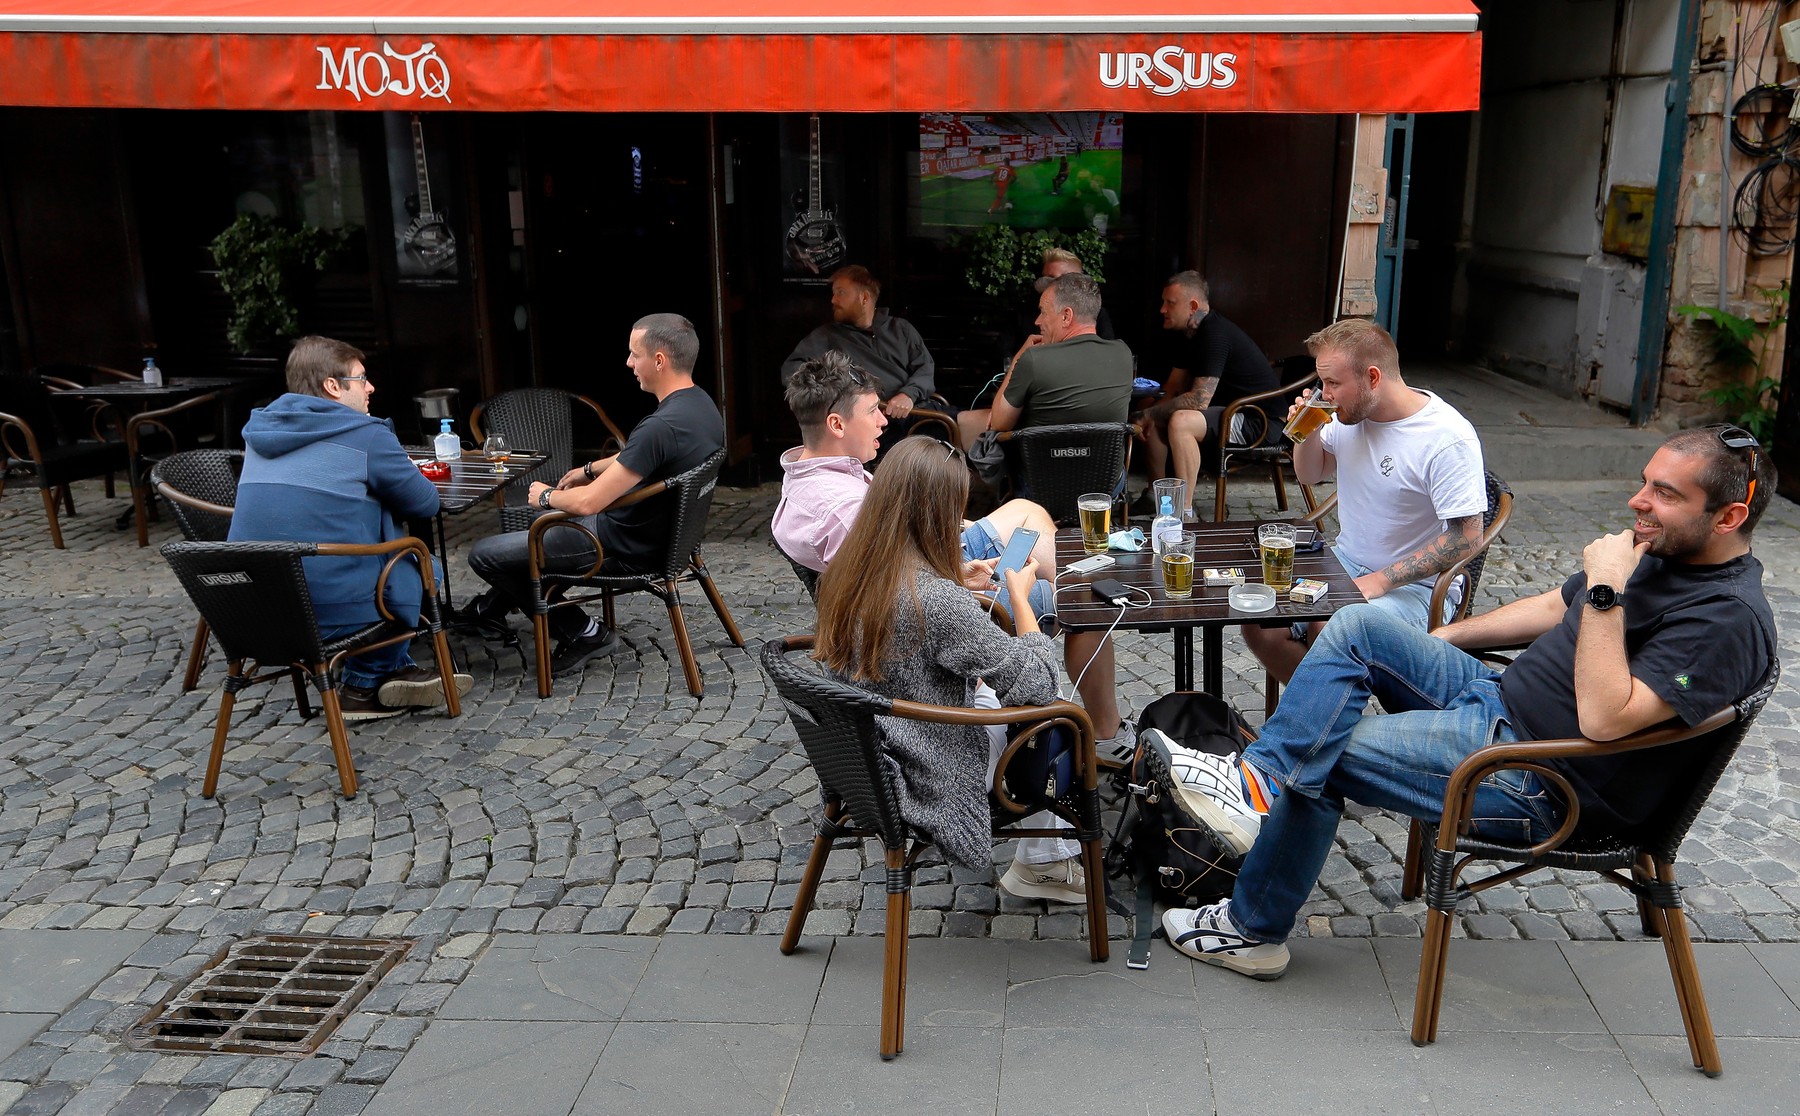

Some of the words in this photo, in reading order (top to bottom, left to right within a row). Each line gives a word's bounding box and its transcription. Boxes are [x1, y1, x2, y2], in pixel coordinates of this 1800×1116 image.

[316, 41, 452, 104] MOJO
[1099, 45, 1238, 97] URSUS
[936, 158, 958, 173] QATAR
[998, 169, 1008, 180] 19
[789, 218, 806, 239] JACK
[1054, 448, 1087, 457] URSUS
[202, 573, 247, 586] URSUS
